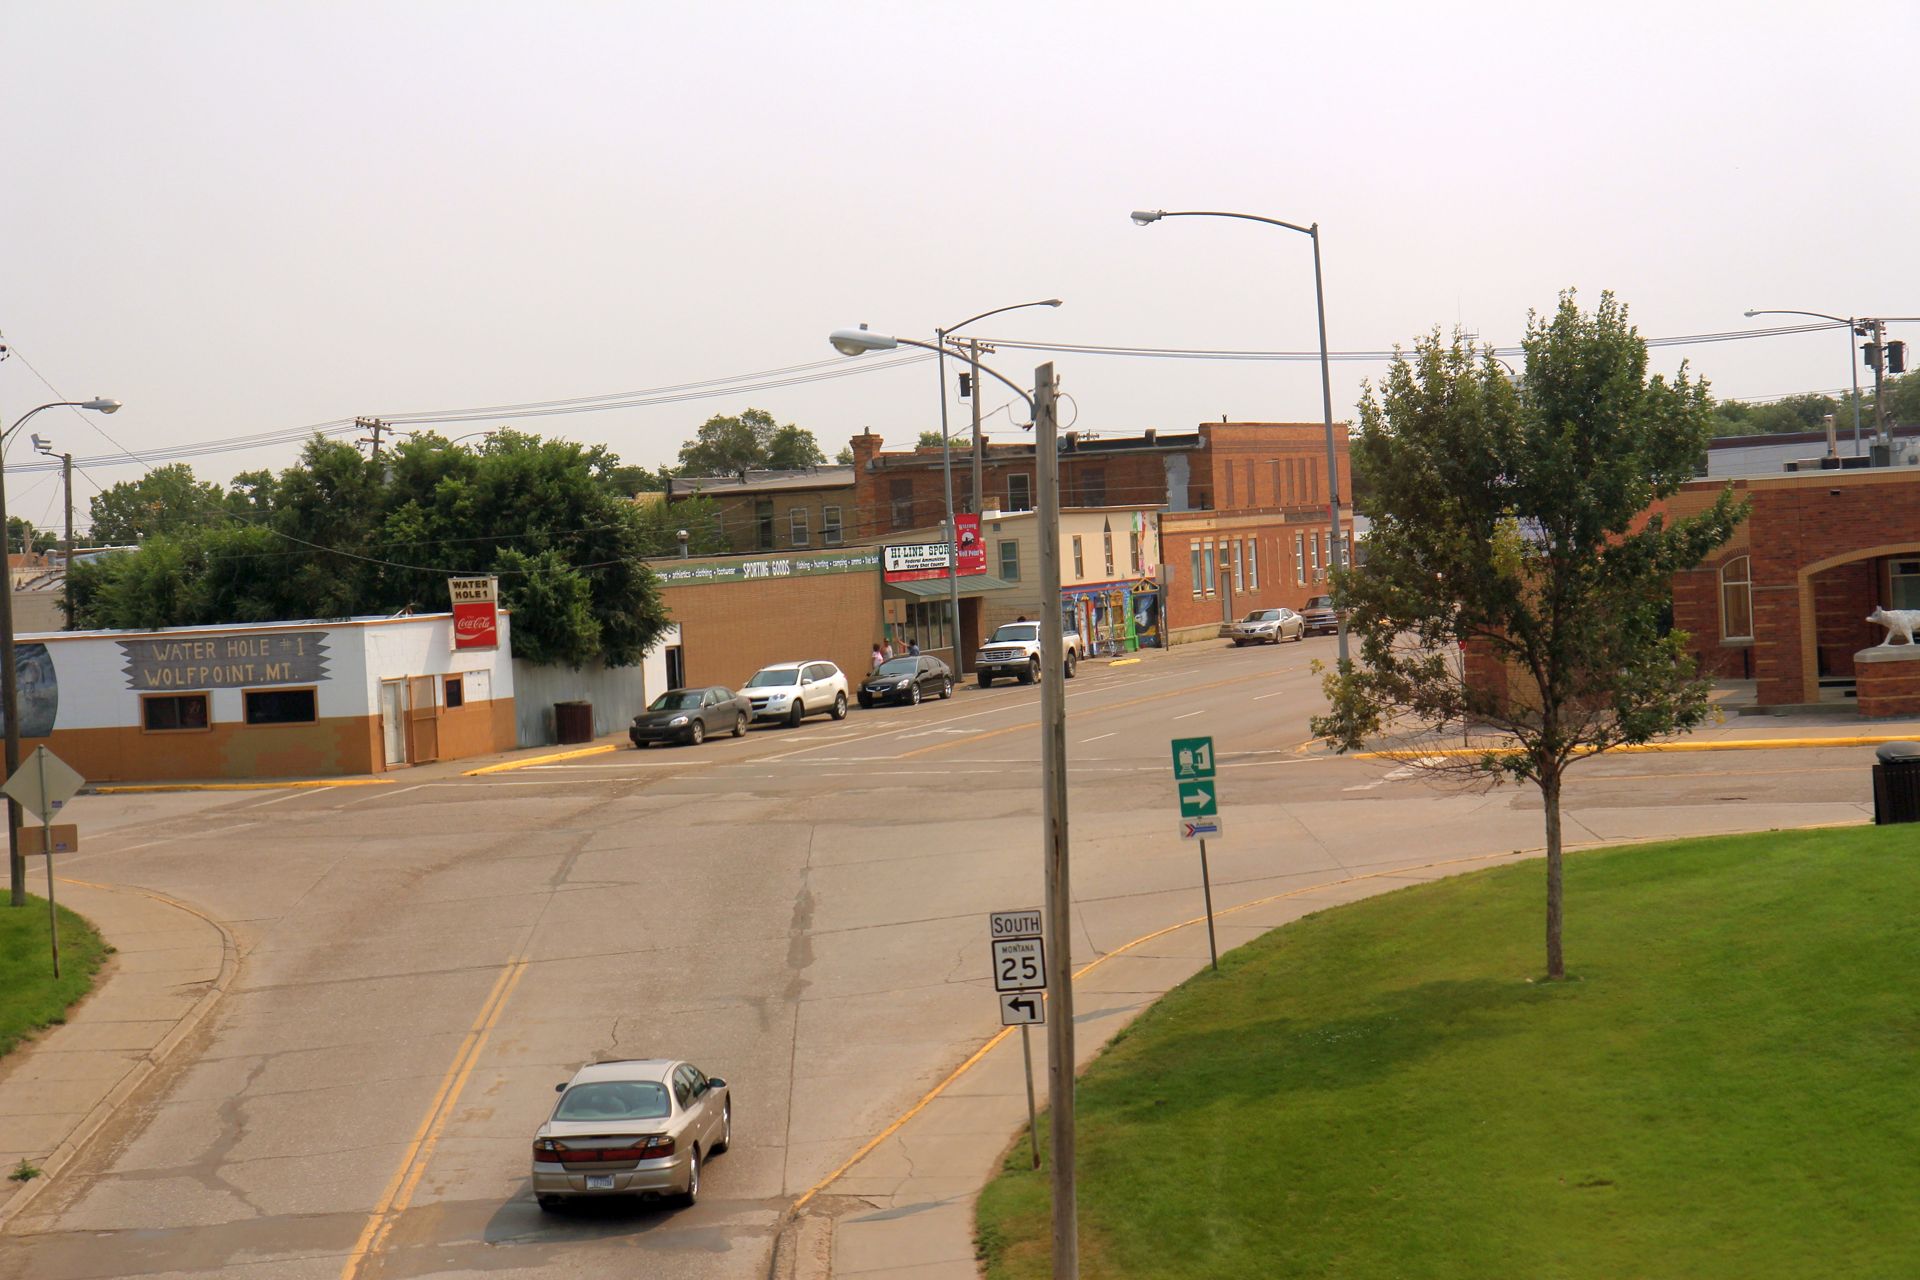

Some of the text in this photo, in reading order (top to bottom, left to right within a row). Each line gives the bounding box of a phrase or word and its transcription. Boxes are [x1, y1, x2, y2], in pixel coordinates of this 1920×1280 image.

[891, 546, 924, 558] HI-LINE
[695, 568, 713, 578] clothing
[716, 567, 736, 576] footwear
[743, 561, 769, 578] SPORTING
[771, 560, 790, 576] GOODS
[797, 561, 810, 571] fishing
[814, 560, 829, 569] hunting
[833, 559, 847, 568] camping
[452, 580, 488, 589] WATER
[455, 590, 488, 599] HOLE 1
[152, 641, 217, 661] WATER
[227, 639, 270, 658] HOLE
[994, 917, 1039, 933] SOUTH
[1002, 944, 1034, 953] MONTANA
[1002, 957, 1037, 981] 25
